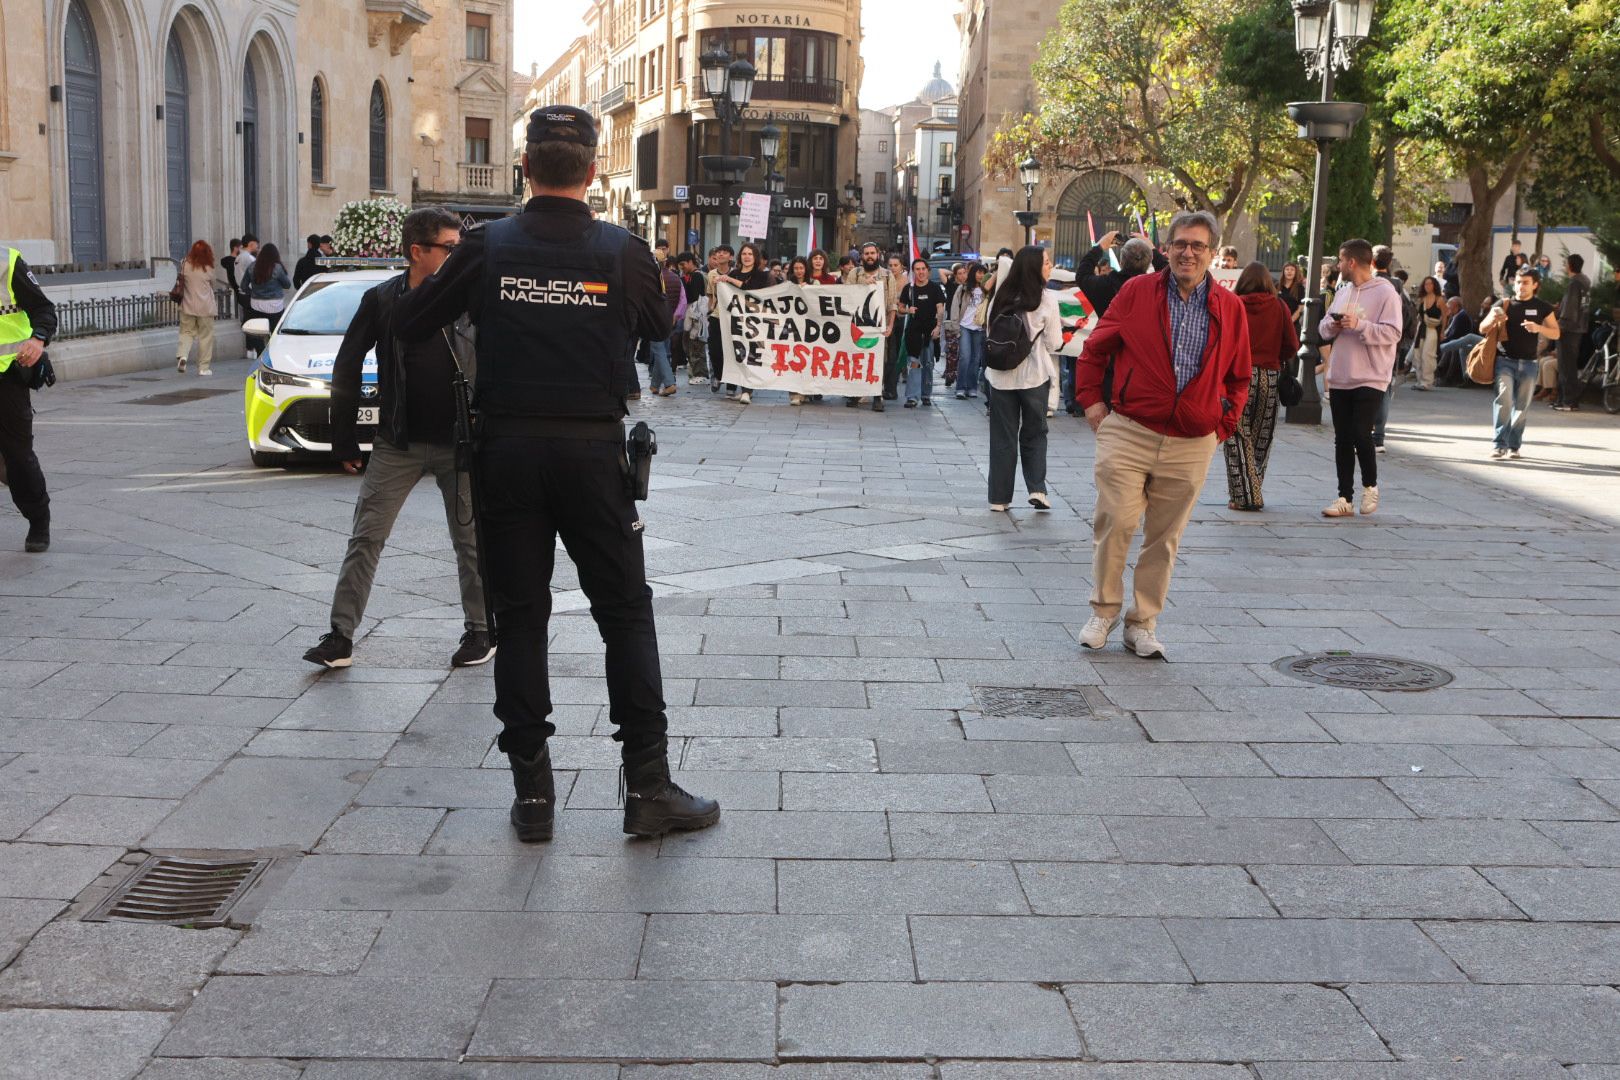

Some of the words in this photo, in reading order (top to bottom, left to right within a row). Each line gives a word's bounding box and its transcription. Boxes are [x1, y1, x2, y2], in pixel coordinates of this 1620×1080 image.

[736, 14, 811, 26] NOTARÍA
[763, 111, 810, 122] AESORÍA
[500, 276, 586, 293] POLICIA
[500, 289, 608, 307] NACIONAL
[726, 294, 809, 315] ABAJO
[819, 296, 851, 317] EL
[730, 316, 841, 344] ESTADO
[732, 340, 765, 366] DE
[771, 343, 880, 384] ISRAEL
